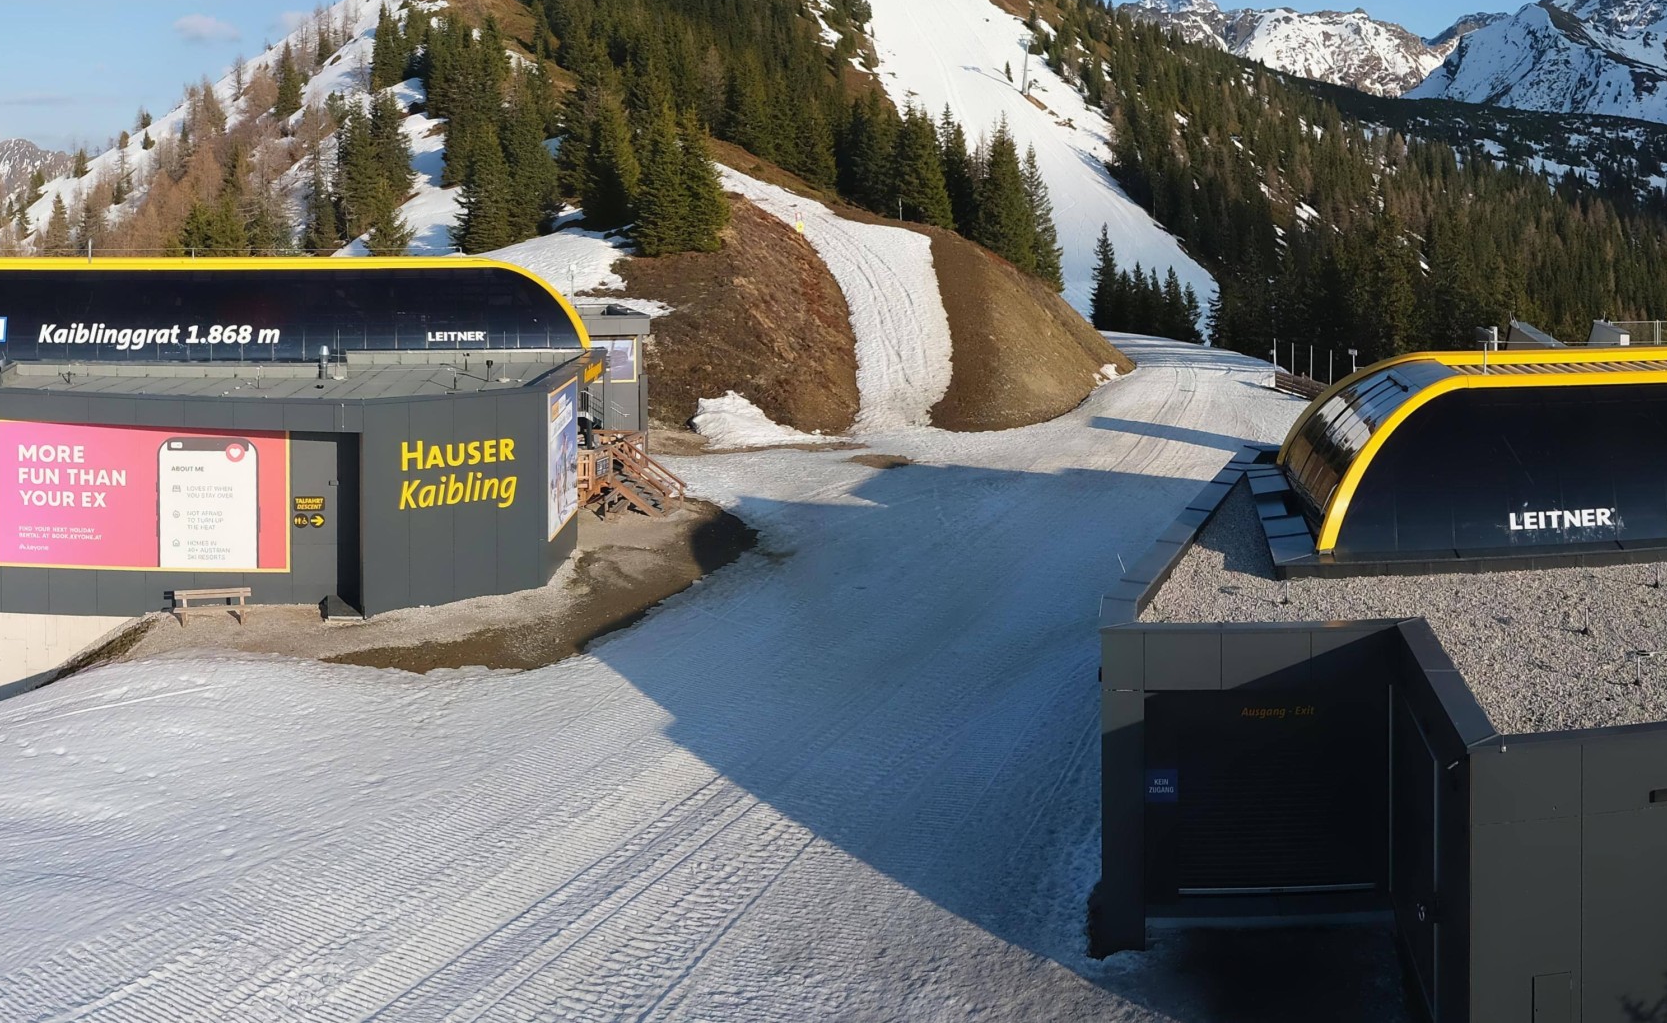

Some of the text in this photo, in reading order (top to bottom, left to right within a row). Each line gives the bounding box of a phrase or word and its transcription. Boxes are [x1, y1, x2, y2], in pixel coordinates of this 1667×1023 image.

[38, 323, 281, 351] Kaiblinggrat 1.868 m
[18, 444, 85, 463] MORE
[401, 438, 516, 472] HAUSER
[18, 467, 127, 487] FUN THAN
[19, 490, 107, 508] YOUR EX
[399, 471, 518, 511] Kaibling
[1241, 706, 1286, 719] Ausgang
[1295, 705, 1315, 716] Exit
[1148, 786, 1174, 794] ZUGANG
[1153, 778, 1169, 786] KEIN
